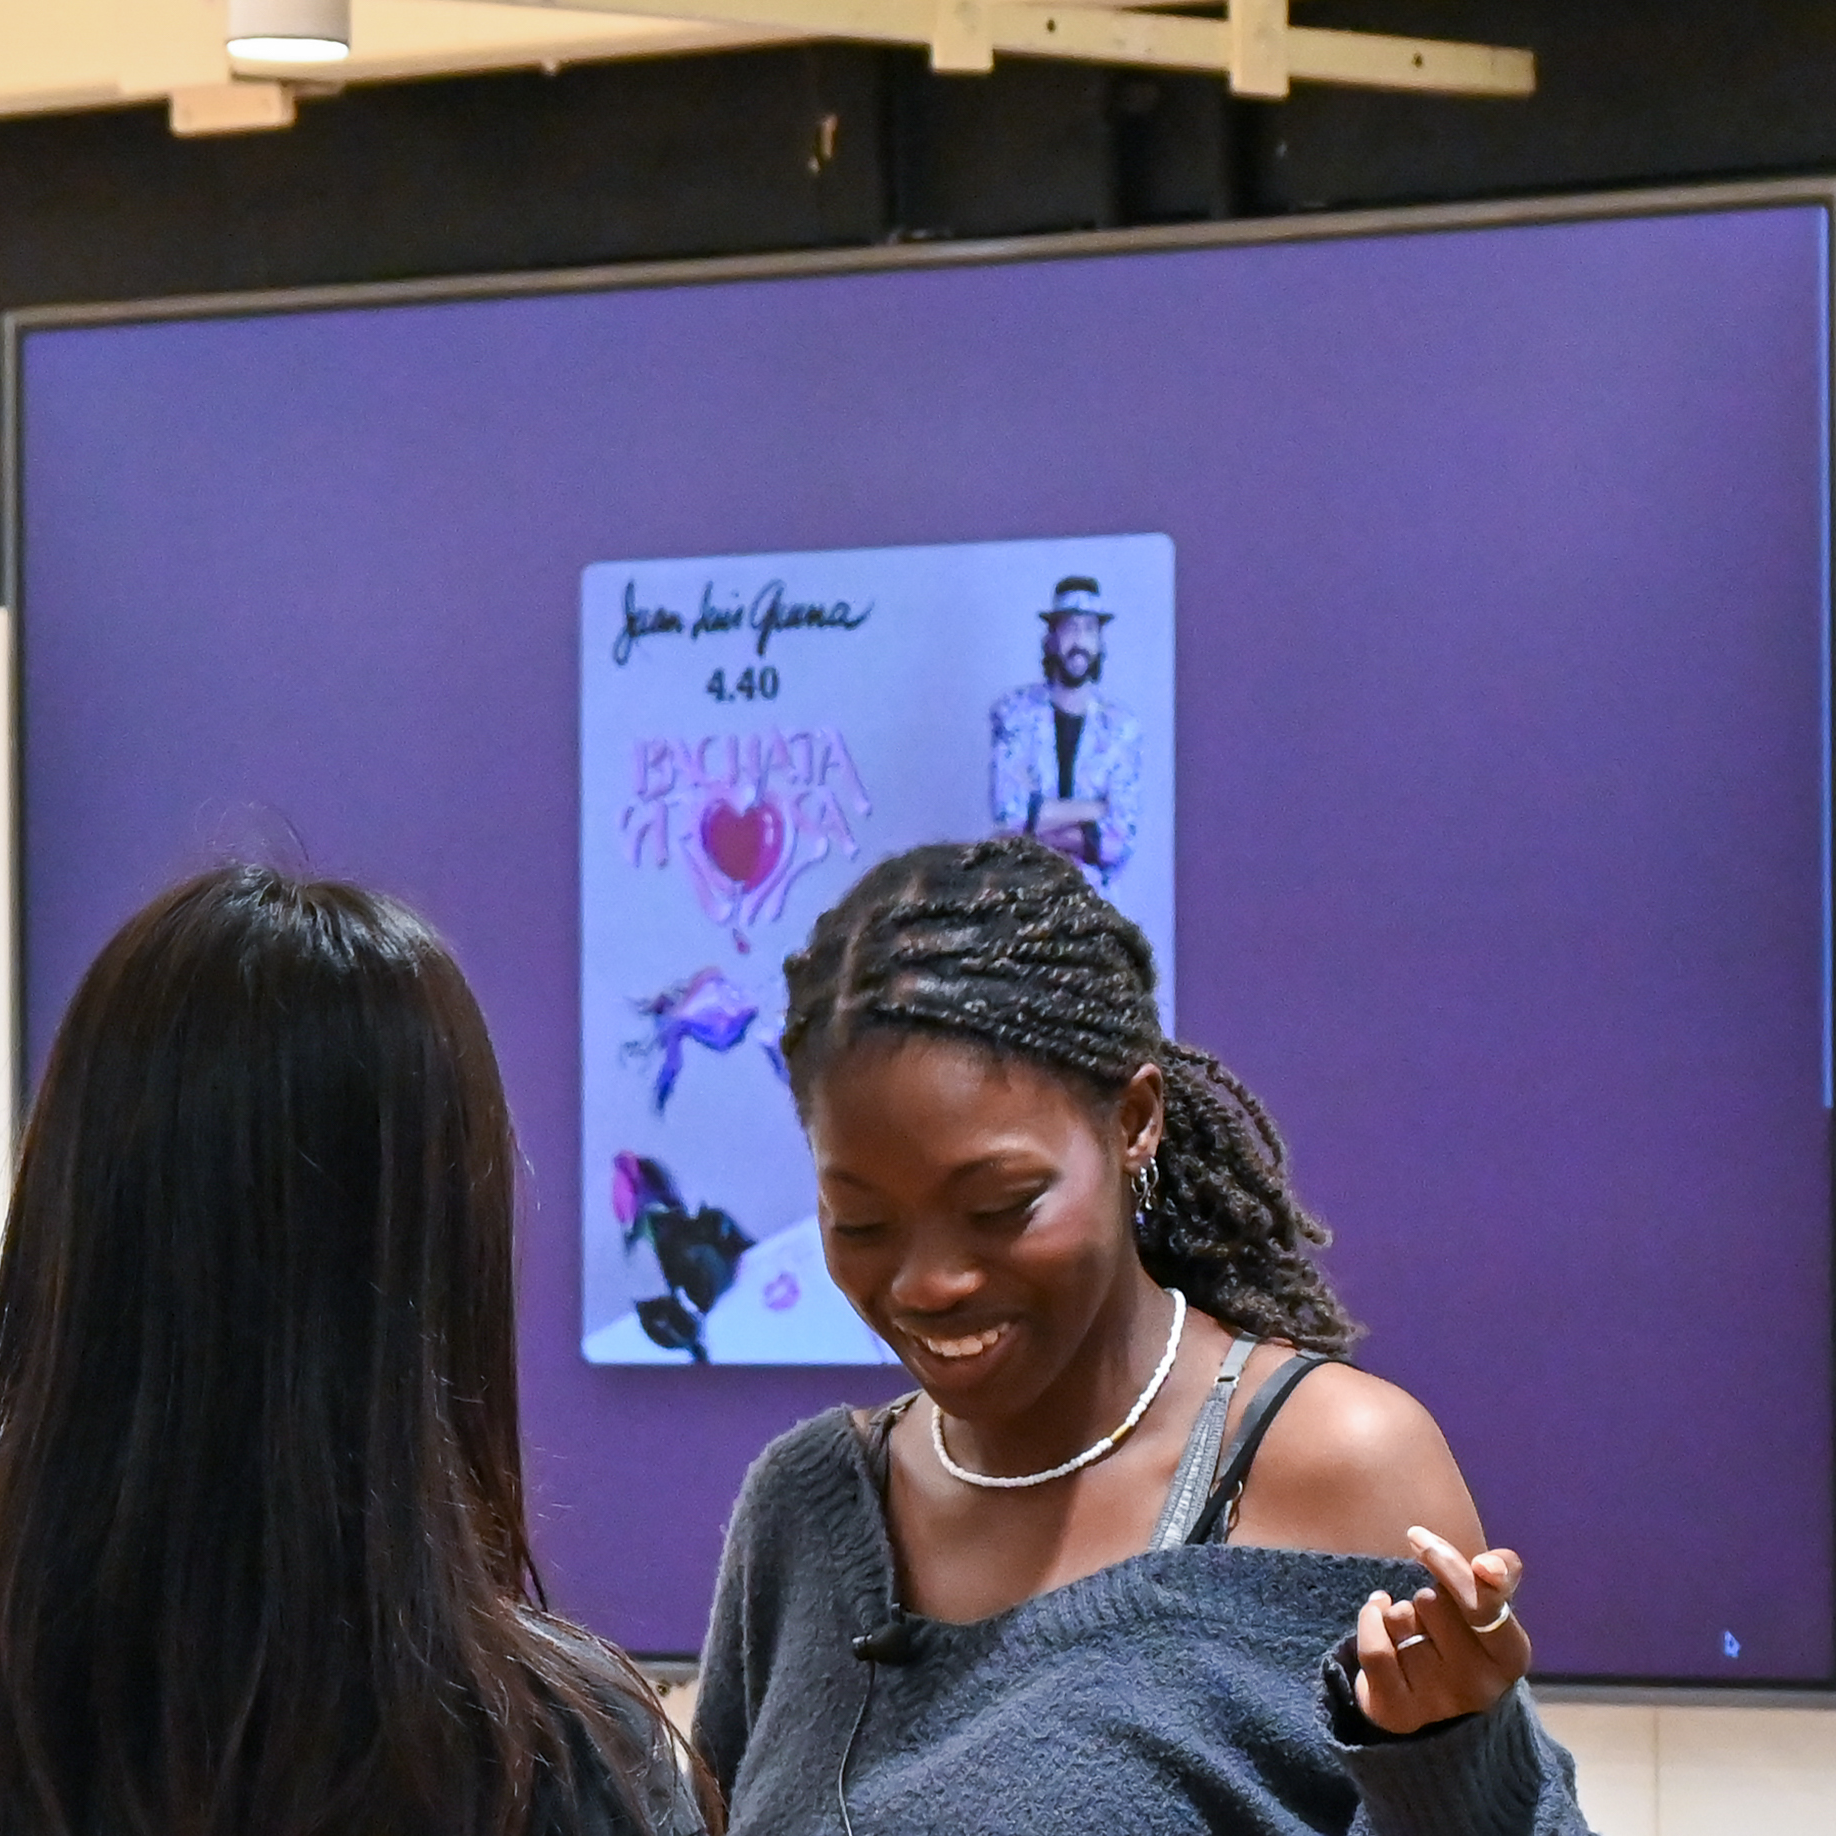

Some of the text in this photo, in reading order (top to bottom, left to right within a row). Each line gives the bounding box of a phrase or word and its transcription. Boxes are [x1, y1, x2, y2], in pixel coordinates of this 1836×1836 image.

[613, 578, 685, 667] Juan
[691, 580, 746, 641] Luis
[706, 667, 780, 702] 4.40
[631, 725, 873, 818] BACHATA
